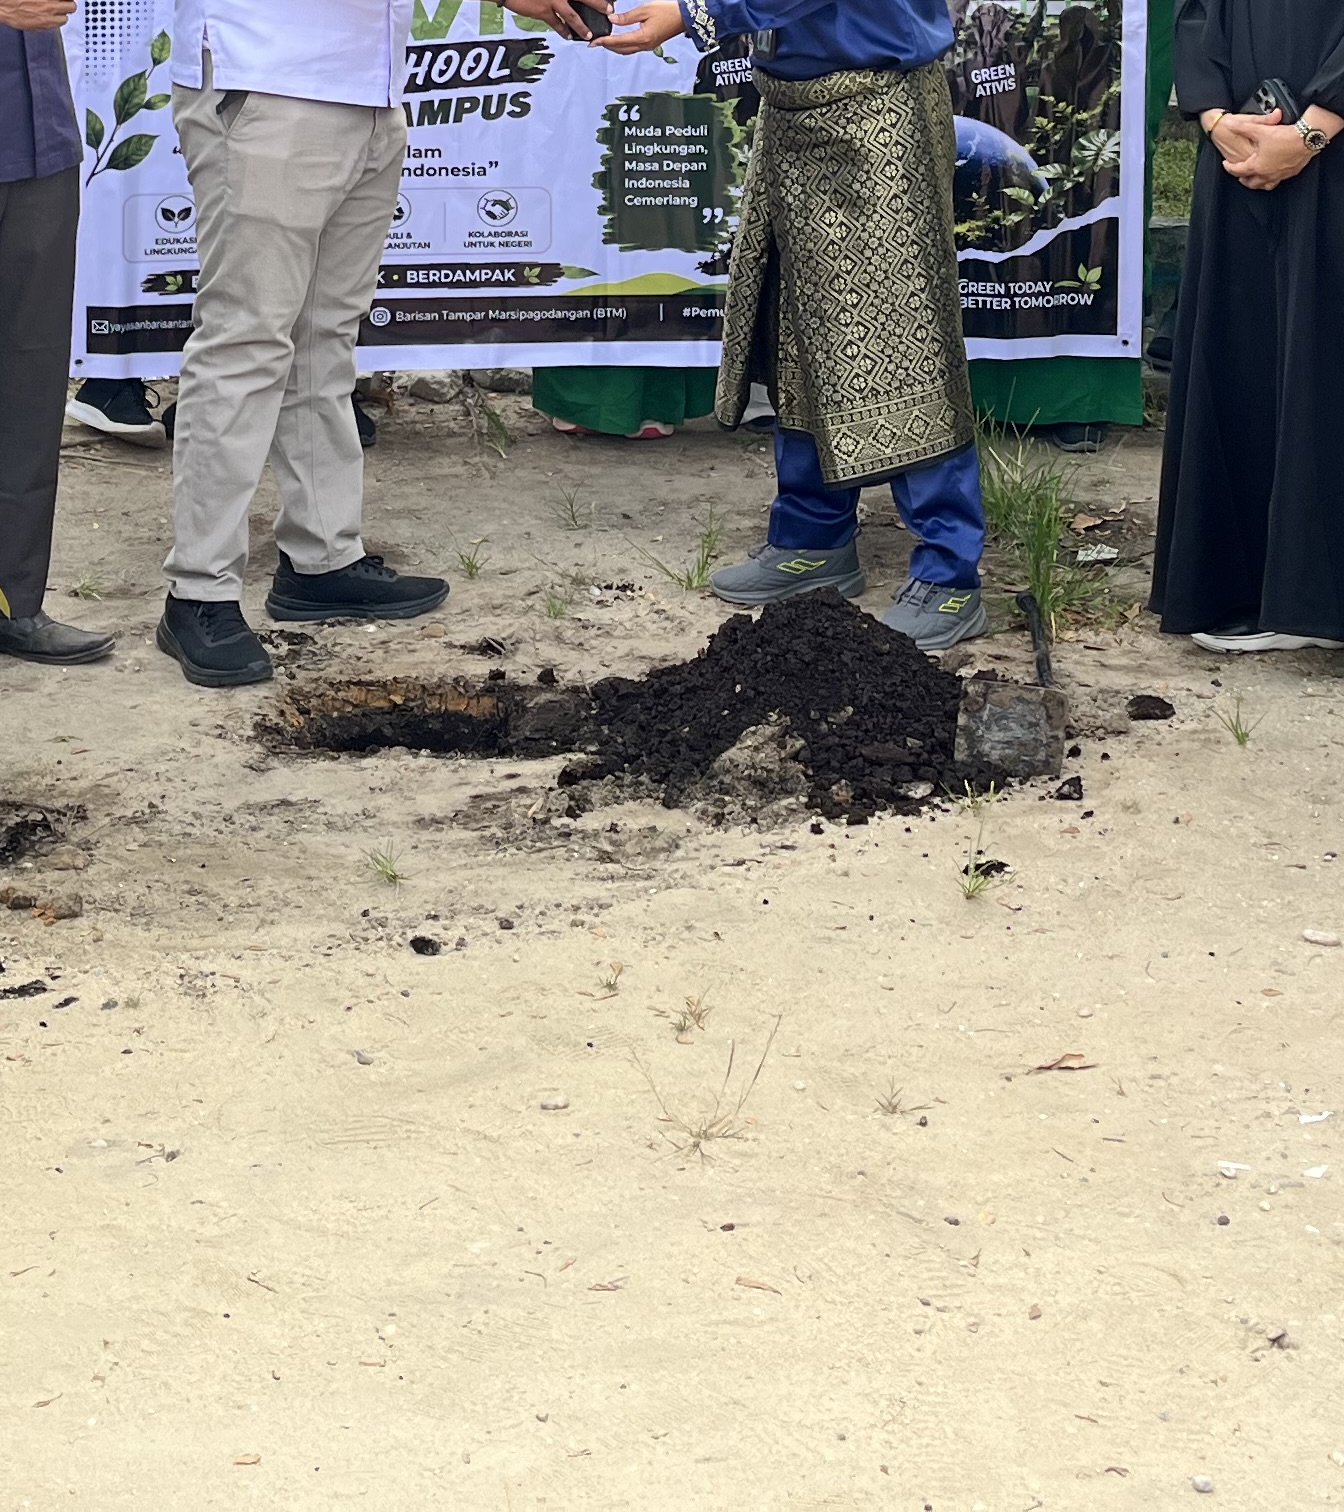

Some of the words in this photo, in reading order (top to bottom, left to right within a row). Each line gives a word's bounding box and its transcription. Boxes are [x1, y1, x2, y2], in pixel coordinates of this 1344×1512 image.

[406, 45, 511, 86] HOOL
[711, 56, 752, 74] GREEN
[715, 70, 753, 87] ATIVIS
[970, 62, 1016, 84] GREEN
[975, 77, 1017, 98] ATIVIS
[402, 91, 532, 128] AMPUS
[624, 126, 661, 137] Muda
[665, 125, 708, 137] Peduli
[406, 145, 442, 159] lam
[624, 143, 709, 156] Lingkungan,
[401, 160, 499, 178] ndonesia”
[624, 161, 659, 172] Masa
[662, 160, 707, 173] Depan
[624, 177, 690, 189] Indonesia
[624, 195, 698, 208] Cemerlang
[468, 230, 529, 239] KOLABORASI
[144, 247, 198, 256] LINGKUNG
[463, 240, 496, 249] UNTUK
[498, 240, 533, 248] NEGERI
[406, 268, 516, 284] BERDAMPAK
[958, 279, 1005, 295] GREEN
[1008, 281, 1053, 295] TODAY
[960, 296, 1012, 310] BETTER
[395, 311, 439, 322] Barisan
[441, 310, 486, 324] Tampar
[488, 307, 591, 323] Marsipagodangan
[593, 307, 627, 320] (BTM)
[682, 307, 726, 318] #Pemu
